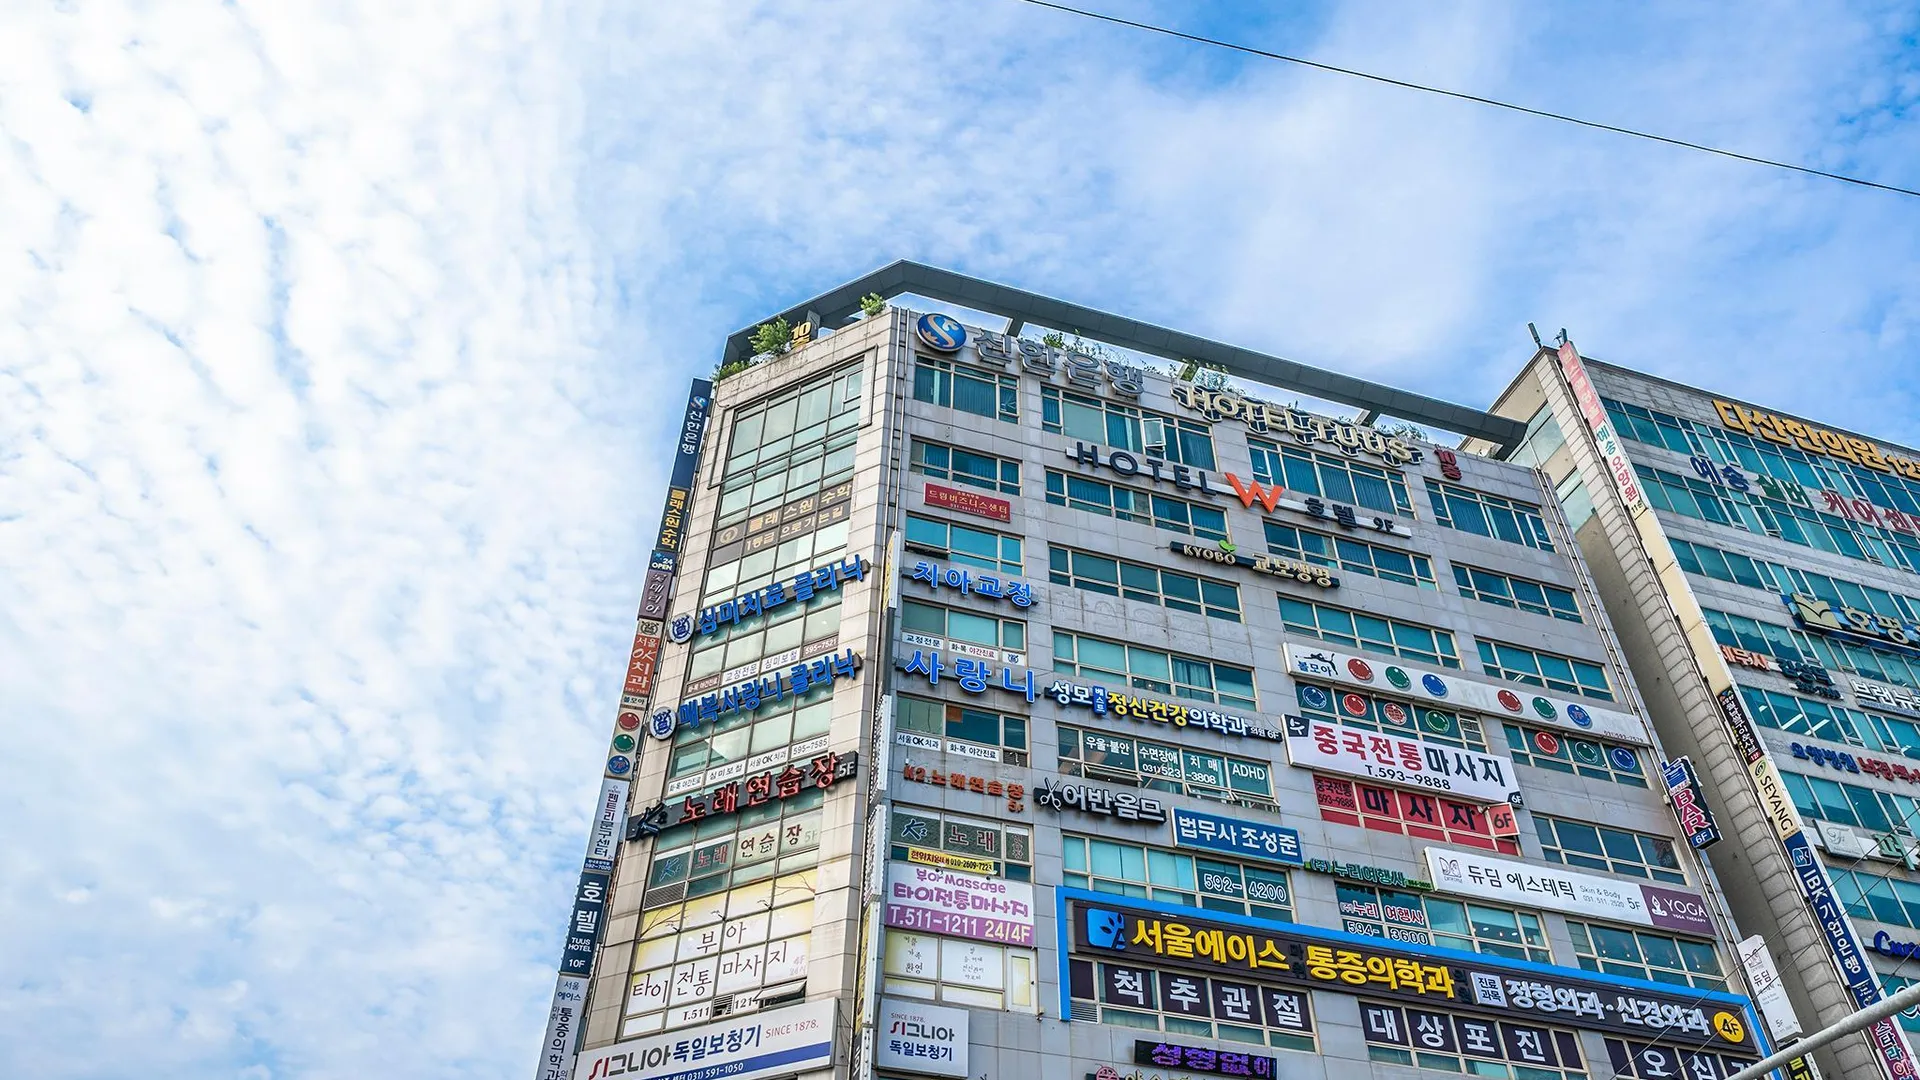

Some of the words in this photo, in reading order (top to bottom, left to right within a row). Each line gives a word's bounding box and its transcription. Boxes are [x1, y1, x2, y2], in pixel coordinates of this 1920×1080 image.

[973, 327, 1144, 398] 신한은행
[682, 411, 701, 454] 신한은행
[1172, 386, 1313, 444] HOTEL
[1312, 418, 1422, 466] TUUS
[1712, 399, 1890, 473] 다산한의원
[1597, 426, 1616, 455] 예송
[1076, 440, 1218, 496] HOTEL
[1612, 456, 1638, 502] 요양원
[821, 484, 852, 504] 수학
[929, 490, 1008, 514] 드림비즈니스센터
[1225, 472, 1284, 514] W
[1305, 498, 1358, 530] 호텔
[1372, 517, 1394, 533] 9F
[1184, 544, 1236, 565] KYOBO
[913, 561, 1031, 607] 치아교정
[1252, 553, 1332, 588] 교보생명
[699, 583, 788, 635] 심미치료
[793, 554, 864, 602] 클리닉
[1841, 606, 1920, 645] 호평
[632, 648, 656, 661] OK
[637, 637, 657, 647] 서울
[906, 635, 940, 647] 교정전문
[969, 647, 995, 658] 야간진료
[627, 662, 650, 689] 치과
[679, 672, 783, 728] 매복사랑니
[789, 648, 856, 695] 클리닉
[905, 650, 1034, 702] 사랑니
[1050, 680, 1093, 706] 성모
[1108, 691, 1249, 737] 정신건강의학과
[1267, 729, 1279, 739] 6F
[792, 738, 828, 755] 595-7585
[969, 748, 996, 758] 야간진료
[1086, 736, 1130, 756] 우울·불안
[1139, 746, 1178, 765] 수면장애
[1313, 724, 1506, 787] 중국전통마사지
[709, 764, 743, 780] 심미보철
[1232, 763, 1266, 781] ADHD
[1364, 764, 1451, 790] T.593-9888
[679, 752, 840, 824] 노래연습장
[839, 761, 855, 776] 5F
[1315, 778, 1352, 796] 중국전통
[1511, 794, 1522, 804] 6F
[1062, 784, 1165, 822] 어반옴므
[1673, 788, 1711, 836] BAR
[1760, 776, 1793, 831] SEYANG
[1493, 812, 1512, 829] 6F
[949, 825, 995, 852] 노래
[1178, 816, 1237, 846] 법무사
[1241, 826, 1298, 857] 조성준
[1696, 832, 1708, 844] 6F
[916, 868, 943, 882] 부아
[944, 875, 1006, 894] Massage
[1467, 861, 1503, 888] 듀딤
[1507, 873, 1577, 901] 에스테틱
[576, 882, 603, 933] 호텔
[893, 883, 1029, 918] 타이전통마사지
[1627, 897, 1640, 911] 5F
[1664, 898, 1708, 918] YOGA
[890, 905, 977, 936] T.511-1211
[985, 919, 1030, 942] 24/4F
[568, 943, 592, 953] HOTEL
[571, 937, 591, 945] TUUS
[697, 921, 747, 954] 부아
[569, 959, 586, 968] 10F
[1132, 919, 1290, 971] 서울에이스
[1306, 945, 1455, 999] 통증의학과
[564, 981, 580, 990] 서울
[1478, 975, 1498, 990] 진료
[1482, 989, 1502, 1002] 과목
[558, 992, 581, 1002] 에이스
[1114, 970, 1303, 1028] 척추관절
[891, 1012, 908, 1020] SINCE
[1721, 1018, 1739, 1036] 4F
[672, 1024, 762, 1062] 독일보청기
[765, 1024, 792, 1038] SINCE
[1368, 1008, 1546, 1062] 대상포진
[889, 1040, 953, 1061] 독일보청기
[705, 1062, 744, 1077] 591-1050
